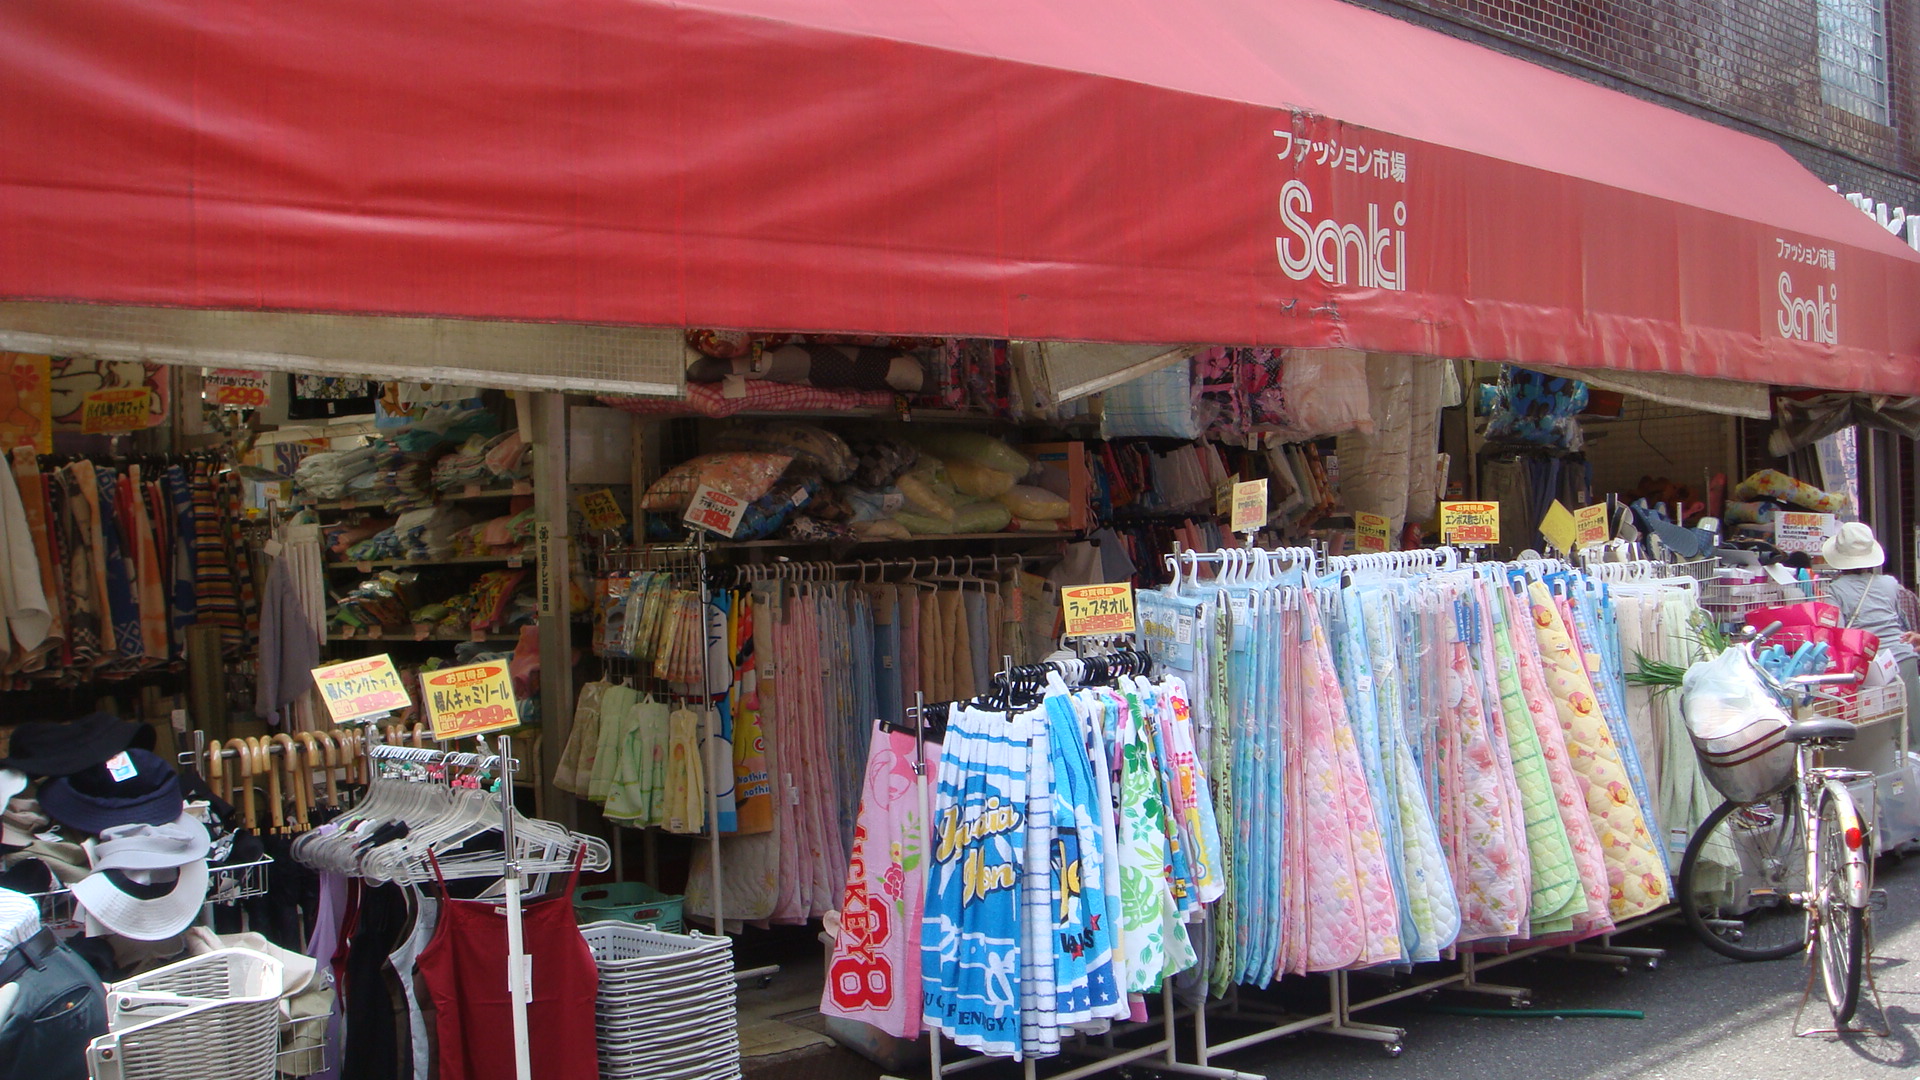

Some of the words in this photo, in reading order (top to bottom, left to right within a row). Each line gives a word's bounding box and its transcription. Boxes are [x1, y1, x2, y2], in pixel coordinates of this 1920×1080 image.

[1273, 130, 1406, 183] ファッション市場
[1276, 179, 1407, 291] Sanki
[1776, 238, 1836, 271] ファッション市場
[1777, 271, 1838, 345] Sanki
[1069, 597, 1129, 618] ラップタオル
